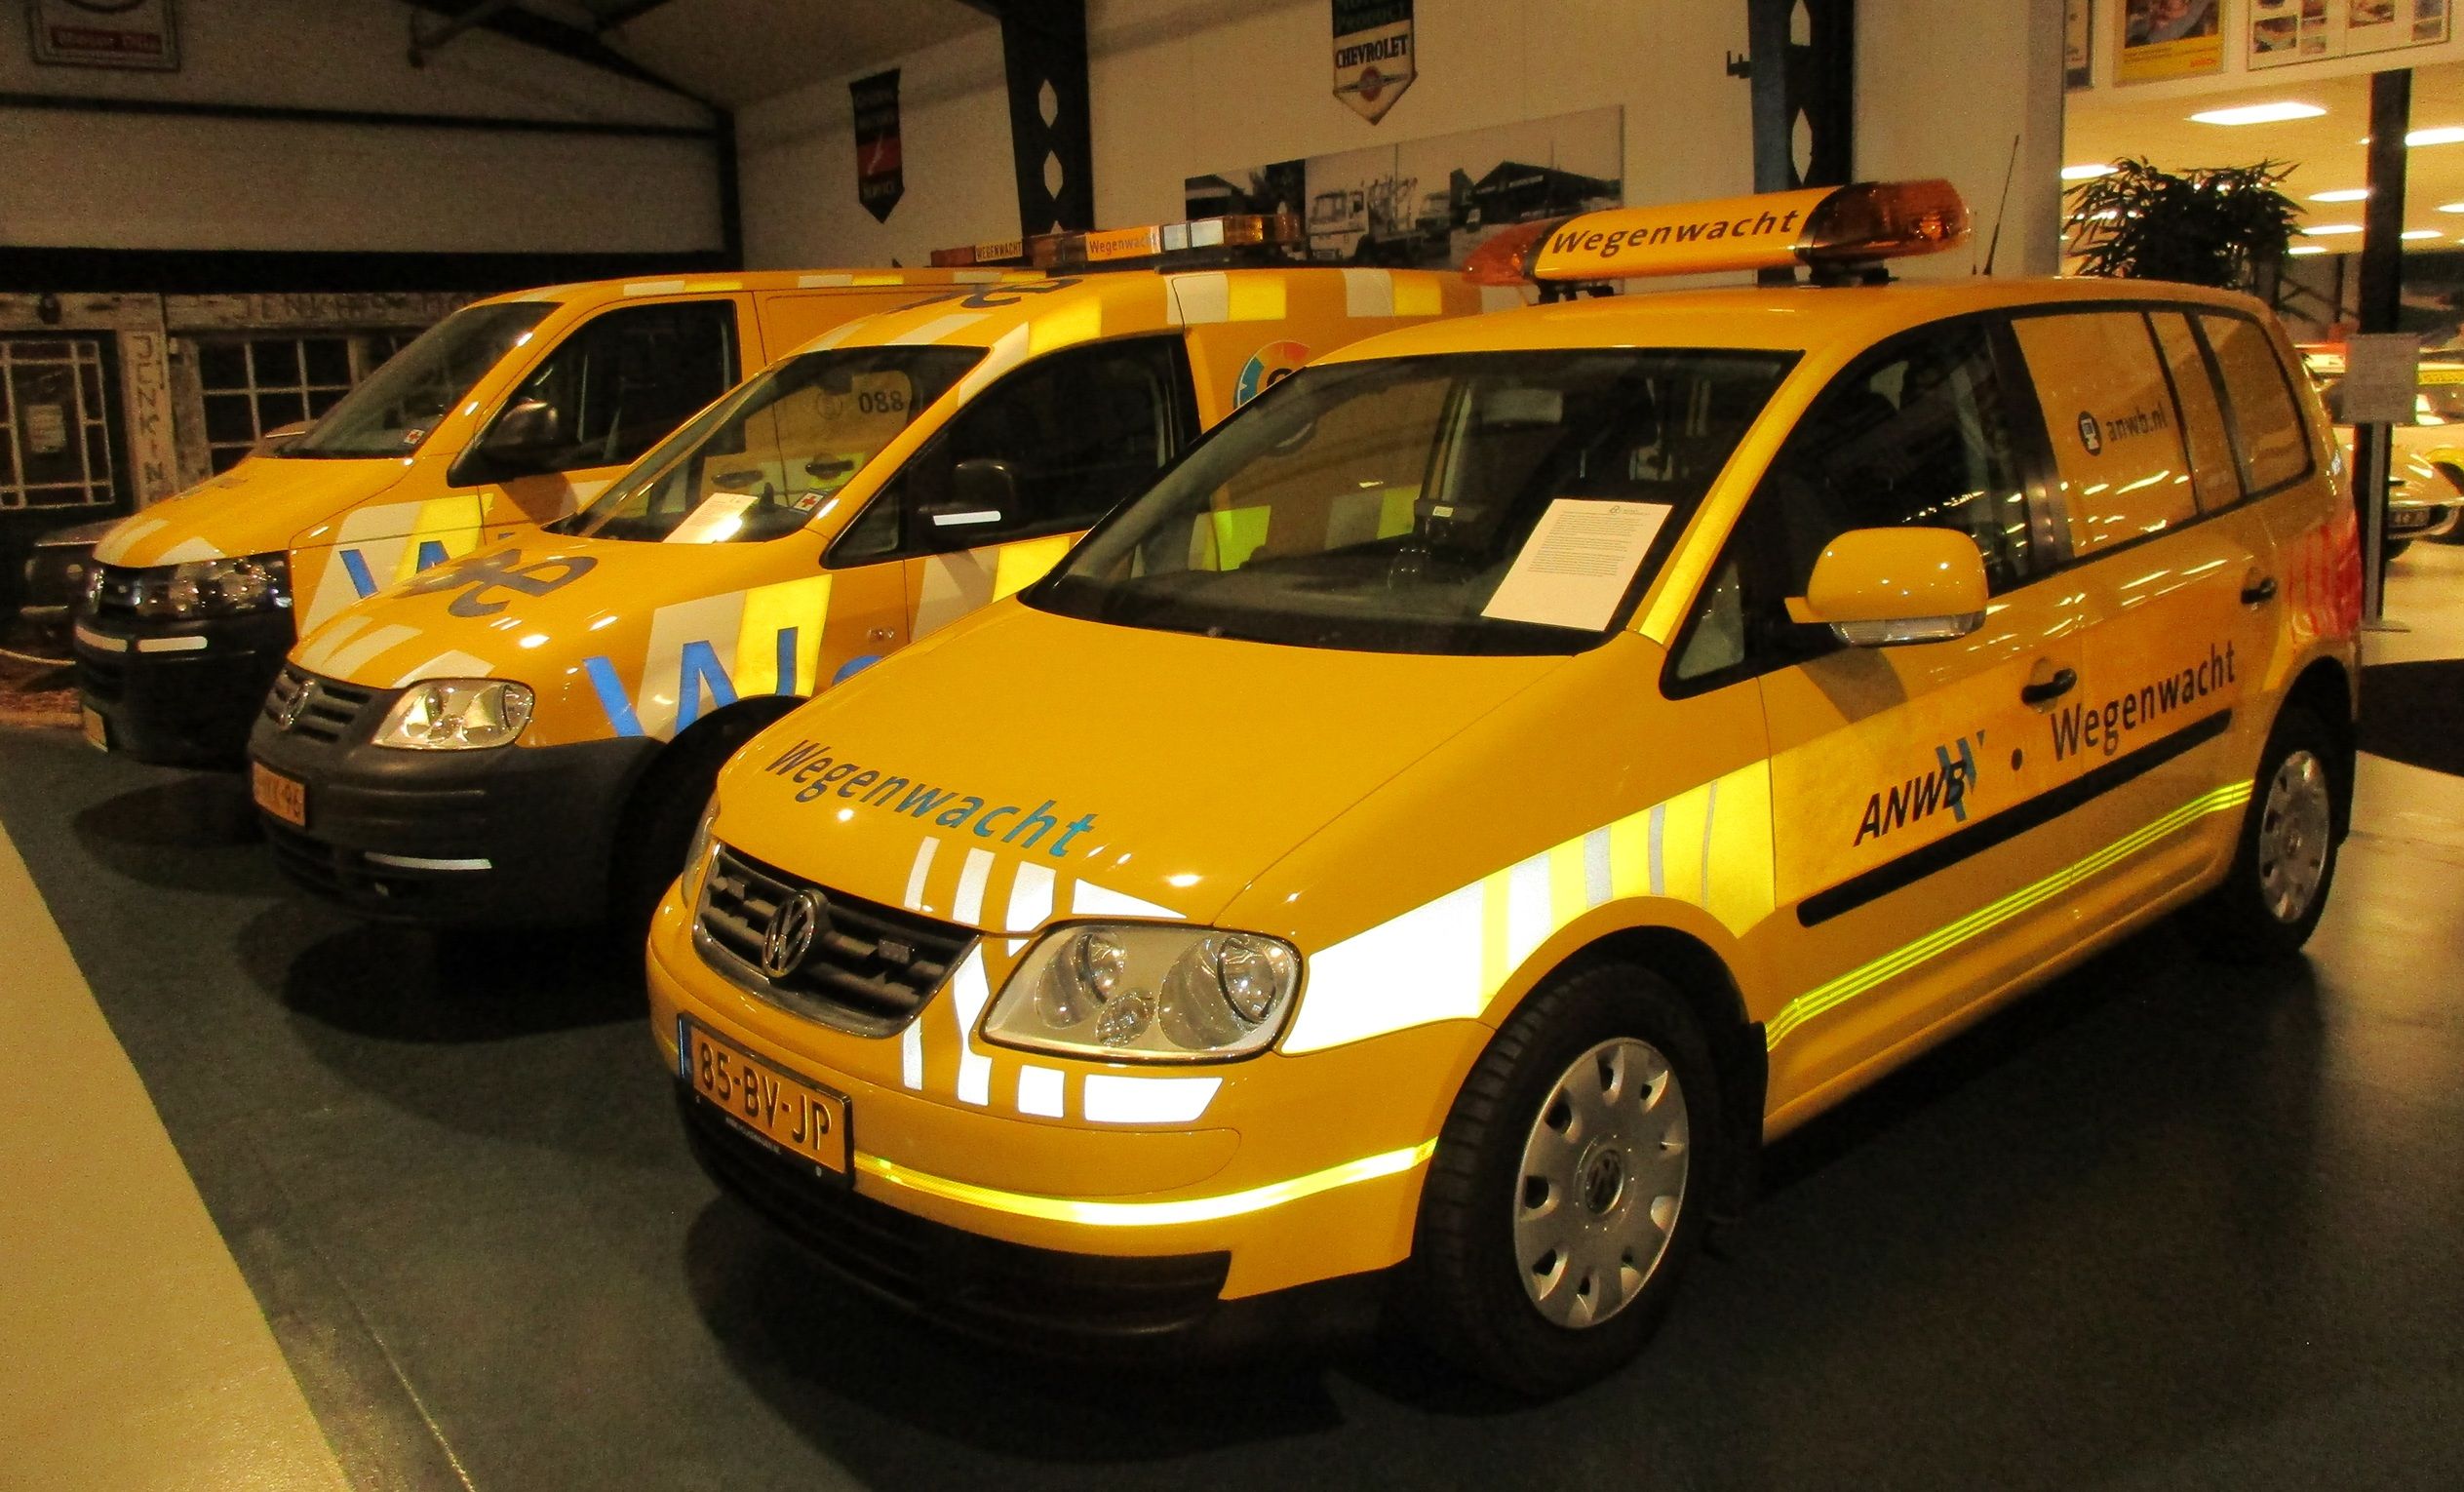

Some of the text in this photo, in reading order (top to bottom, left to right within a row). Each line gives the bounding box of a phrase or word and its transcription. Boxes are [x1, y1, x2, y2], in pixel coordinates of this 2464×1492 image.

[1336, 34, 1408, 68] CHEVROLET
[976, 242, 1022, 260] WEGENWACHT
[1551, 210, 1799, 258] Wegenwacht
[859, 391, 904, 413] 088
[2106, 401, 2169, 443] anwb.nl
[1853, 640, 2236, 847] ANWB Wegenwacht
[764, 739, 1099, 858] Wegenwacht
[700, 1041, 832, 1152] 85-BV-JP
